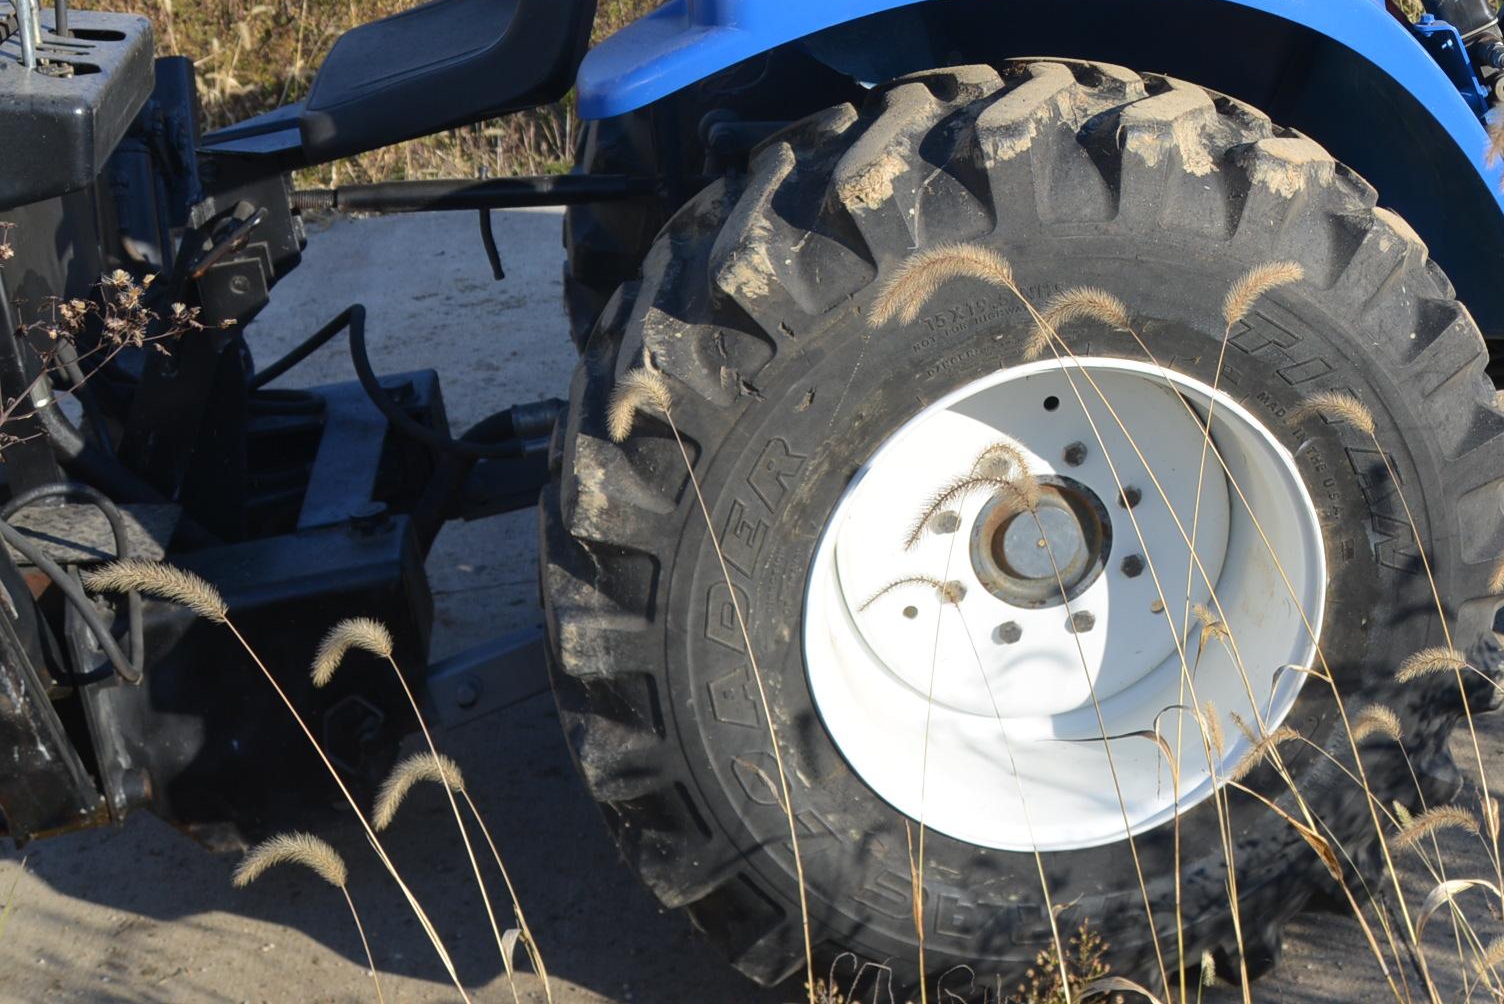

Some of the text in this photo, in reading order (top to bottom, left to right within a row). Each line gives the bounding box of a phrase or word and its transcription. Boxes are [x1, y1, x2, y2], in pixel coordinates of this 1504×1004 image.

[912, 336, 938, 353] NOT
[1256, 390, 1288, 420] MAD
[1306, 447, 1328, 474] THE
[705, 436, 848, 855] LOADER
